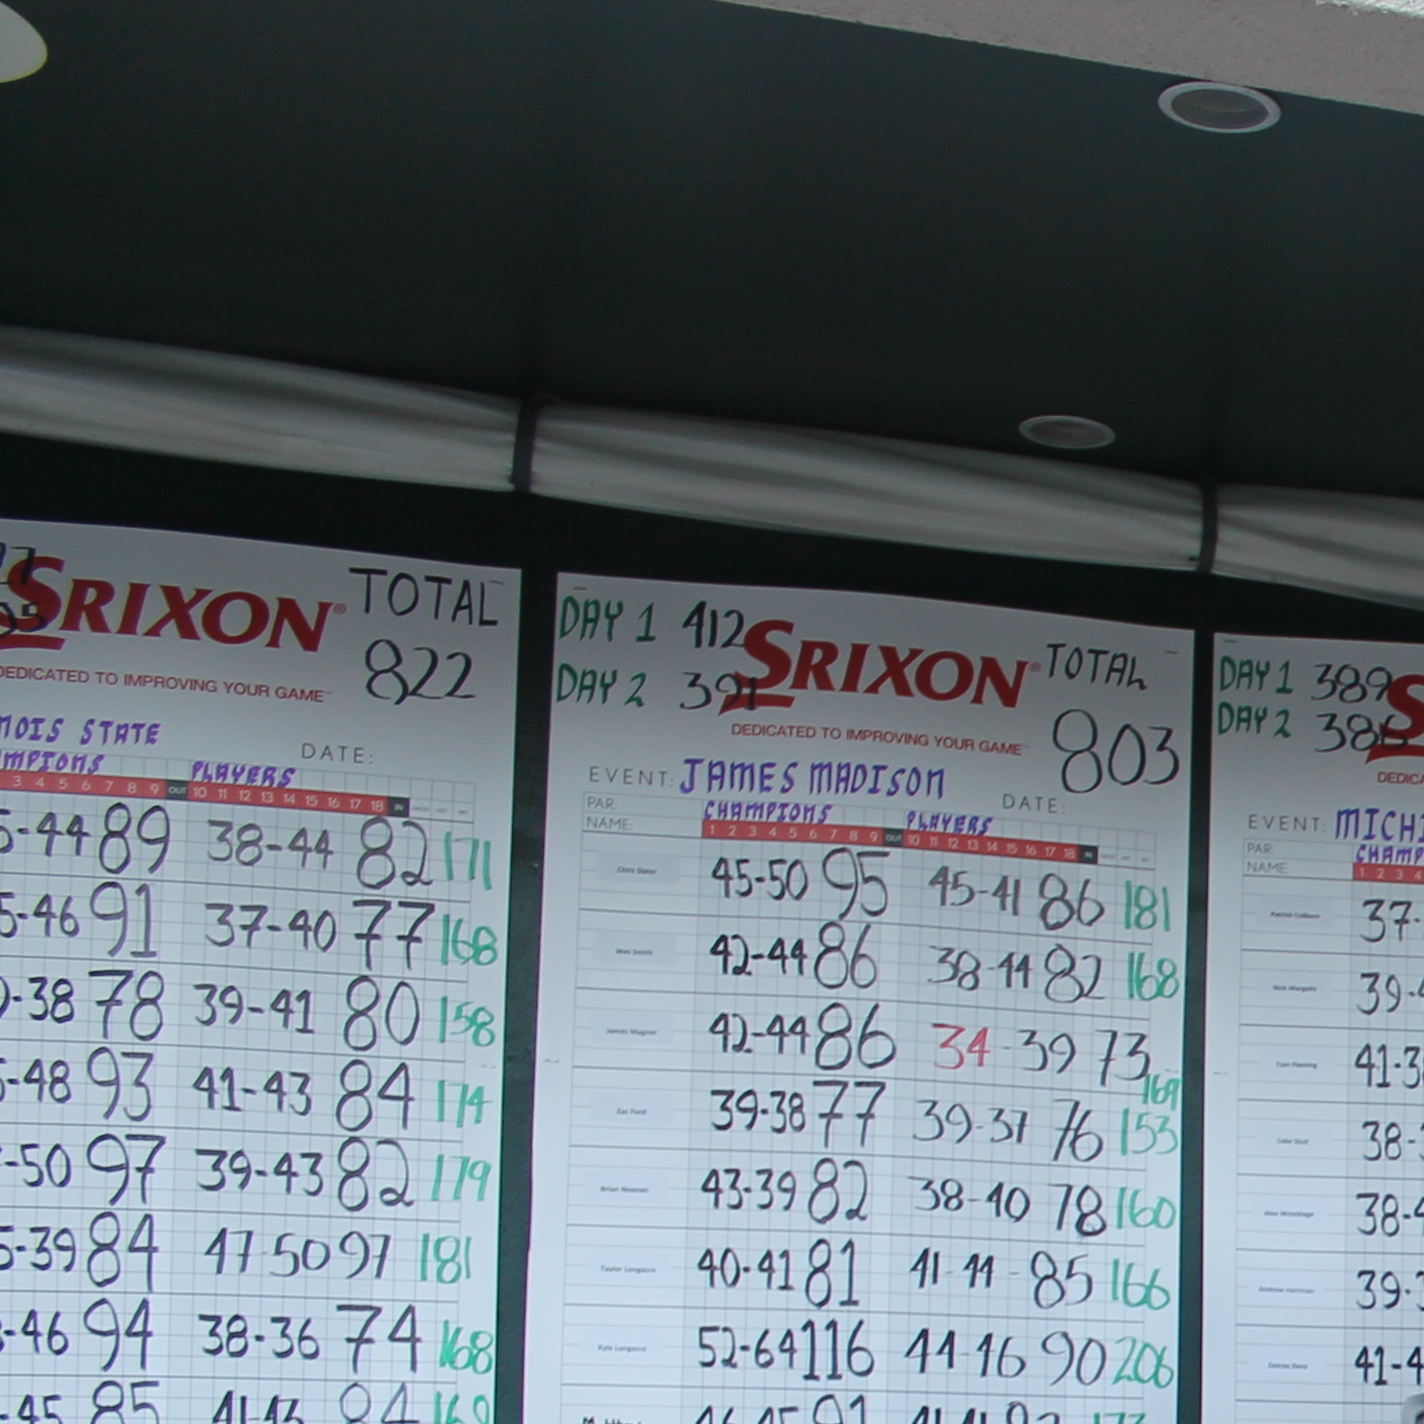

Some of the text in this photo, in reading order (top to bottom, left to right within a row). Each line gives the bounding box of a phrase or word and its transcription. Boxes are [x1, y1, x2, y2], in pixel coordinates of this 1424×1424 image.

[349, 568, 499, 627] TOTAL
[557, 595, 745, 650] DAY 1 412
[124, 674, 324, 703] IMPROVING GAME
[364, 639, 476, 705] 822
[556, 661, 646, 707] DAY 2
[717, 618, 1027, 716] SRIXON
[1046, 643, 1146, 691] TOTAL
[1218, 656, 1393, 702] DAY 1 389
[80, 718, 162, 746] STATE
[732, 723, 1022, 756] DEDICATED TO IMPROVING YOUR GAME
[1218, 702, 1292, 738] DAY 2
[192, 761, 297, 787] PLAYERS
[302, 743, 374, 766] DATE:
[1052, 709, 1180, 794] 803
[589, 766, 675, 788] EVENT:
[680, 758, 945, 798] JAMES MADISON
[704, 800, 993, 836] CHAMPIONS PLAYERS
[1002, 793, 1066, 815] DATE:
[1248, 813, 1327, 834] EVENT:
[98, 802, 492, 890] 89 38-44 82 171
[711, 846, 1171, 932] 45-50 95 45-41 86 181
[90, 881, 499, 970] 91 37-40 77 168
[89, 969, 496, 1051] 78 39-41 80 158
[699, 1319, 1173, 1389] 52-64 116 206
